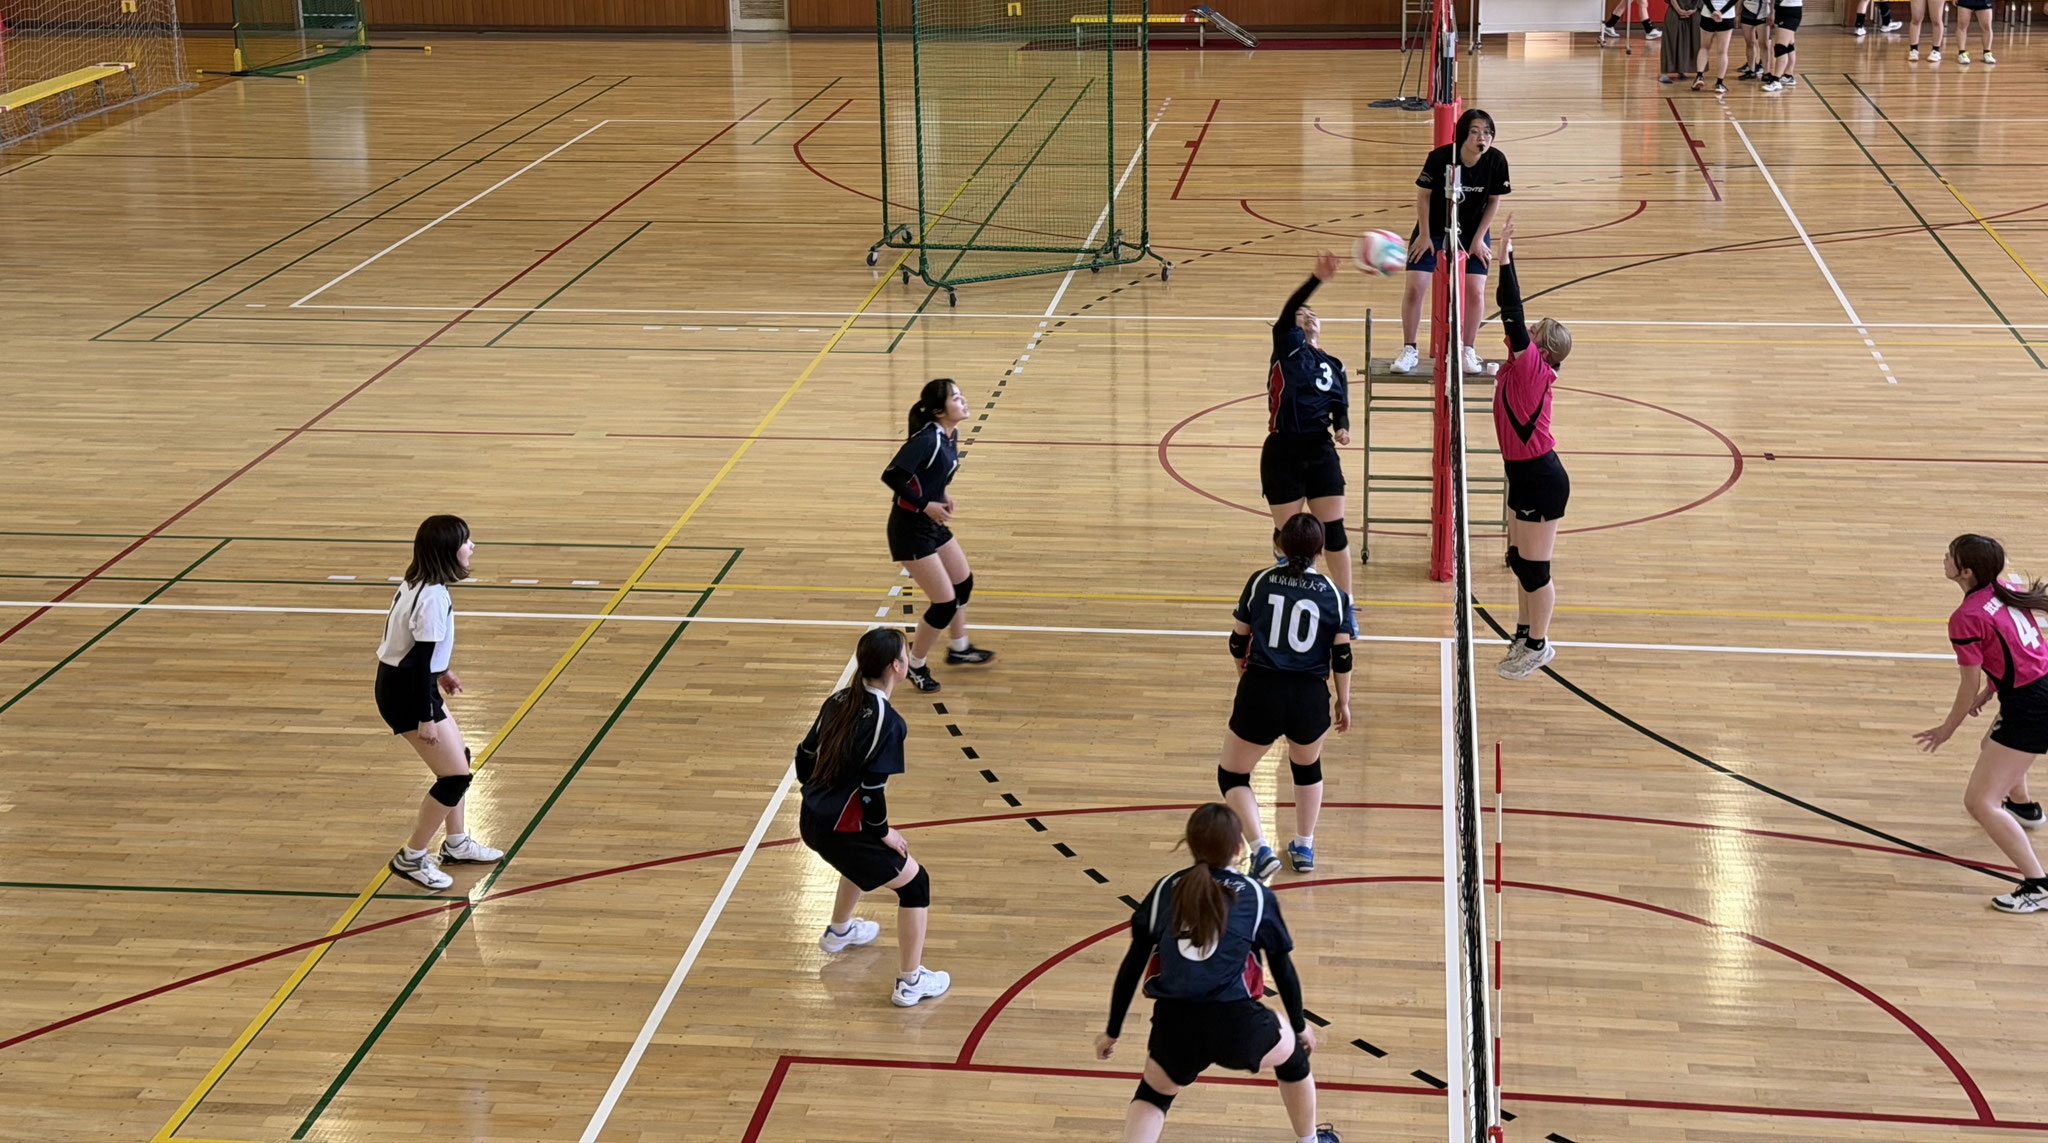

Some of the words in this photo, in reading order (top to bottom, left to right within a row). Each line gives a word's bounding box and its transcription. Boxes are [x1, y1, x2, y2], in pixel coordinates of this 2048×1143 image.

[1315, 362, 1333, 392] 3
[1267, 593, 1321, 653] 10
[2007, 606, 2041, 650] 4
